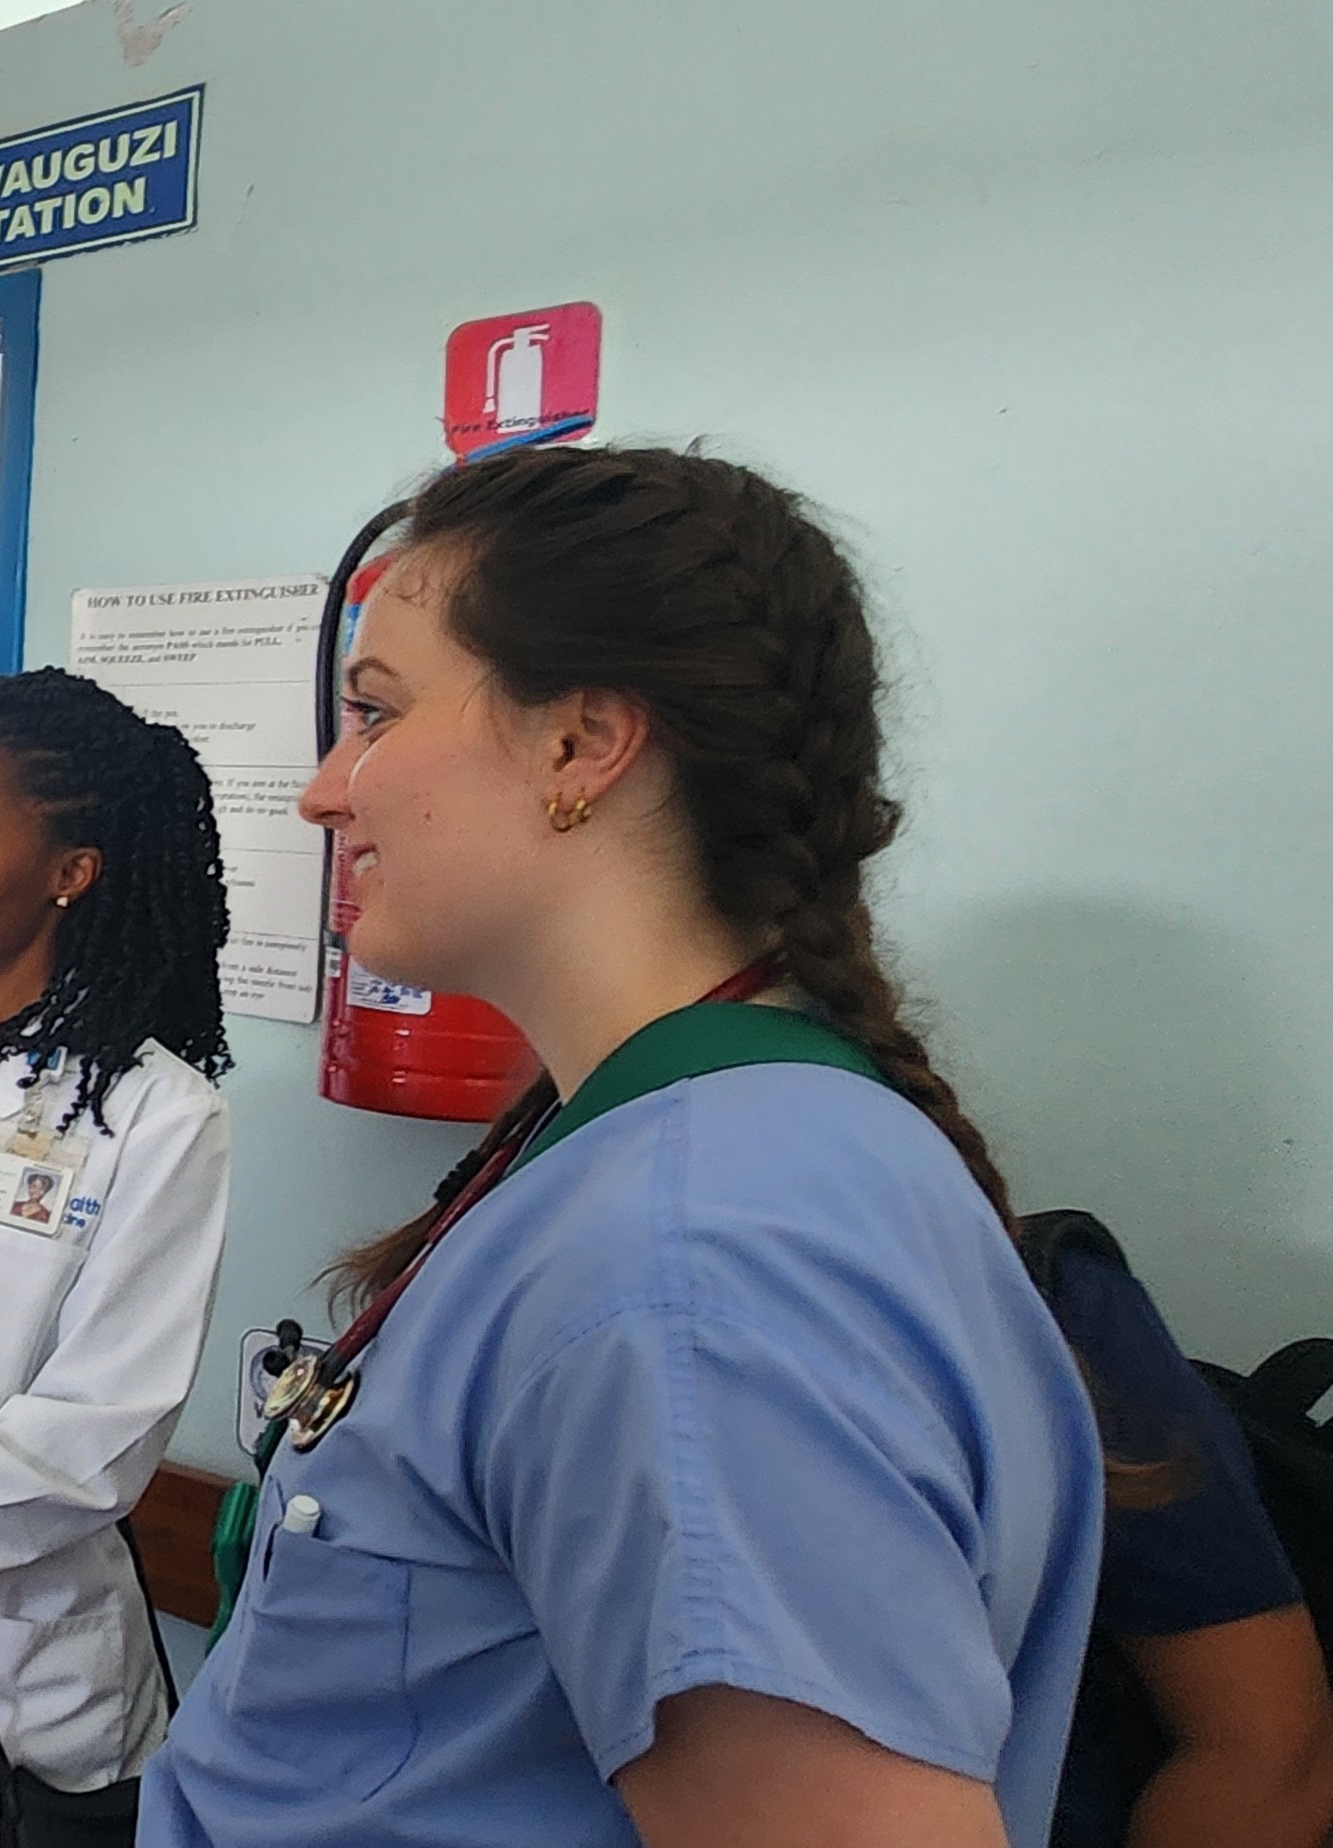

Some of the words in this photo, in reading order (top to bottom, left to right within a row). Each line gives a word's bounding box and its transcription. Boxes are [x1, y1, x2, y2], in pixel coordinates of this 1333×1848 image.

[87, 595, 121, 608] HOW
[126, 594, 146, 607] TO
[149, 593, 176, 605] USE
[179, 591, 212, 605] FIRE
